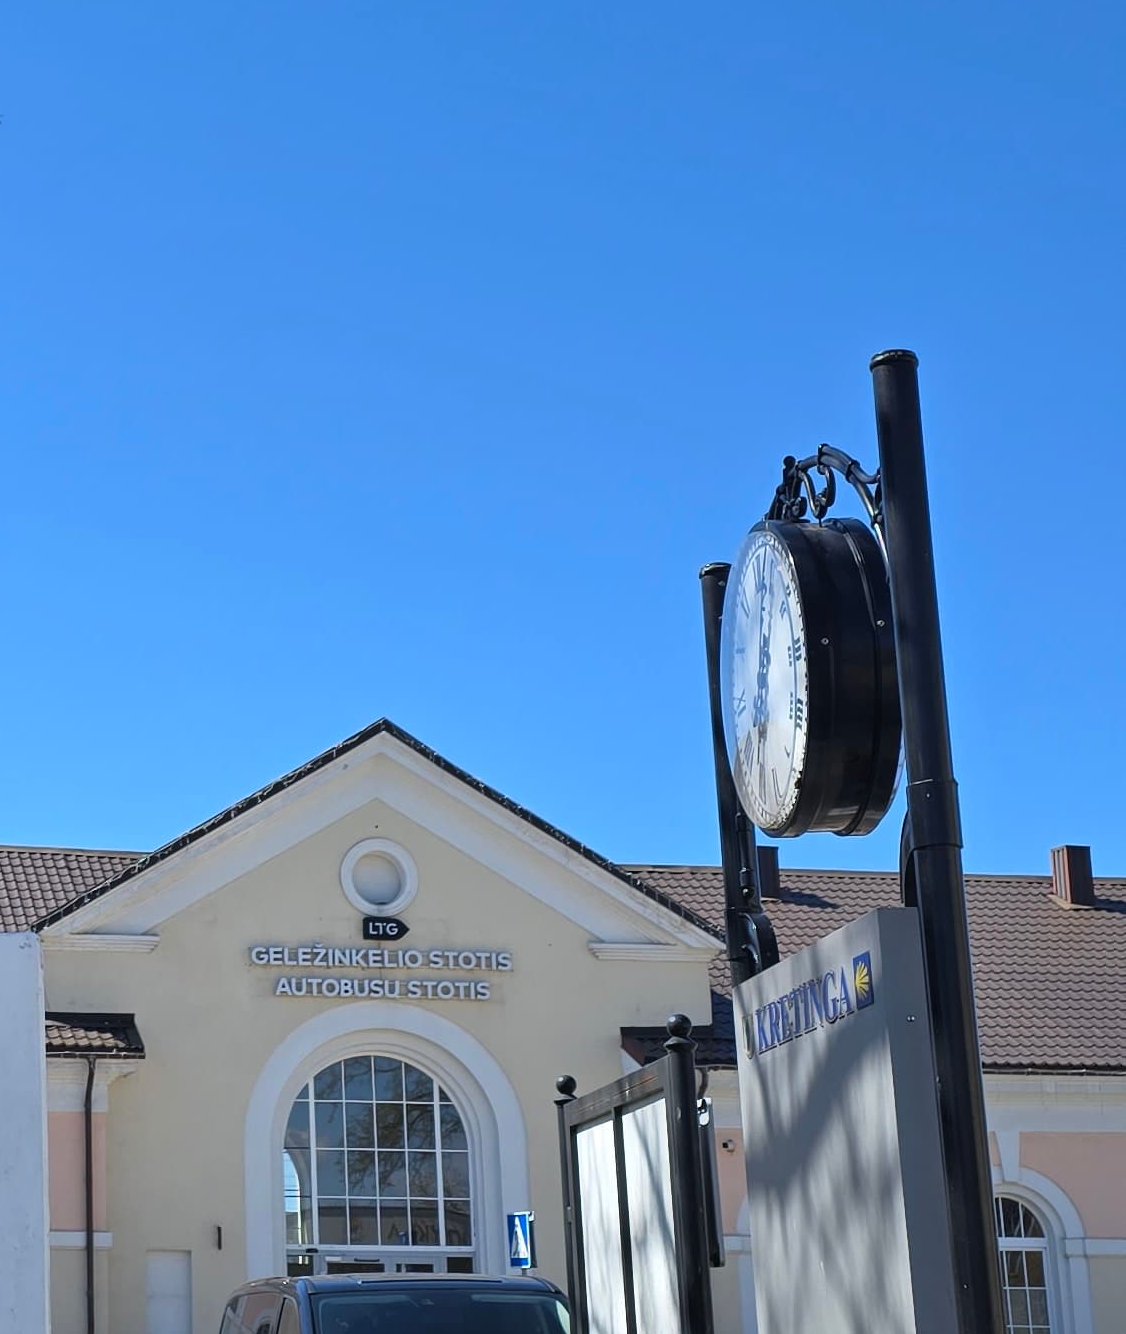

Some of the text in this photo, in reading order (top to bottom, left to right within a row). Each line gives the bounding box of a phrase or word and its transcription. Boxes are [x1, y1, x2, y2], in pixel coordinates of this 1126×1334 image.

[369, 923, 398, 935] LTG
[251, 942, 513, 971] GELEŽINKELIO STOTIS
[407, 981, 491, 1000] STOTIS
[755, 966, 852, 1053] KRETINGA
